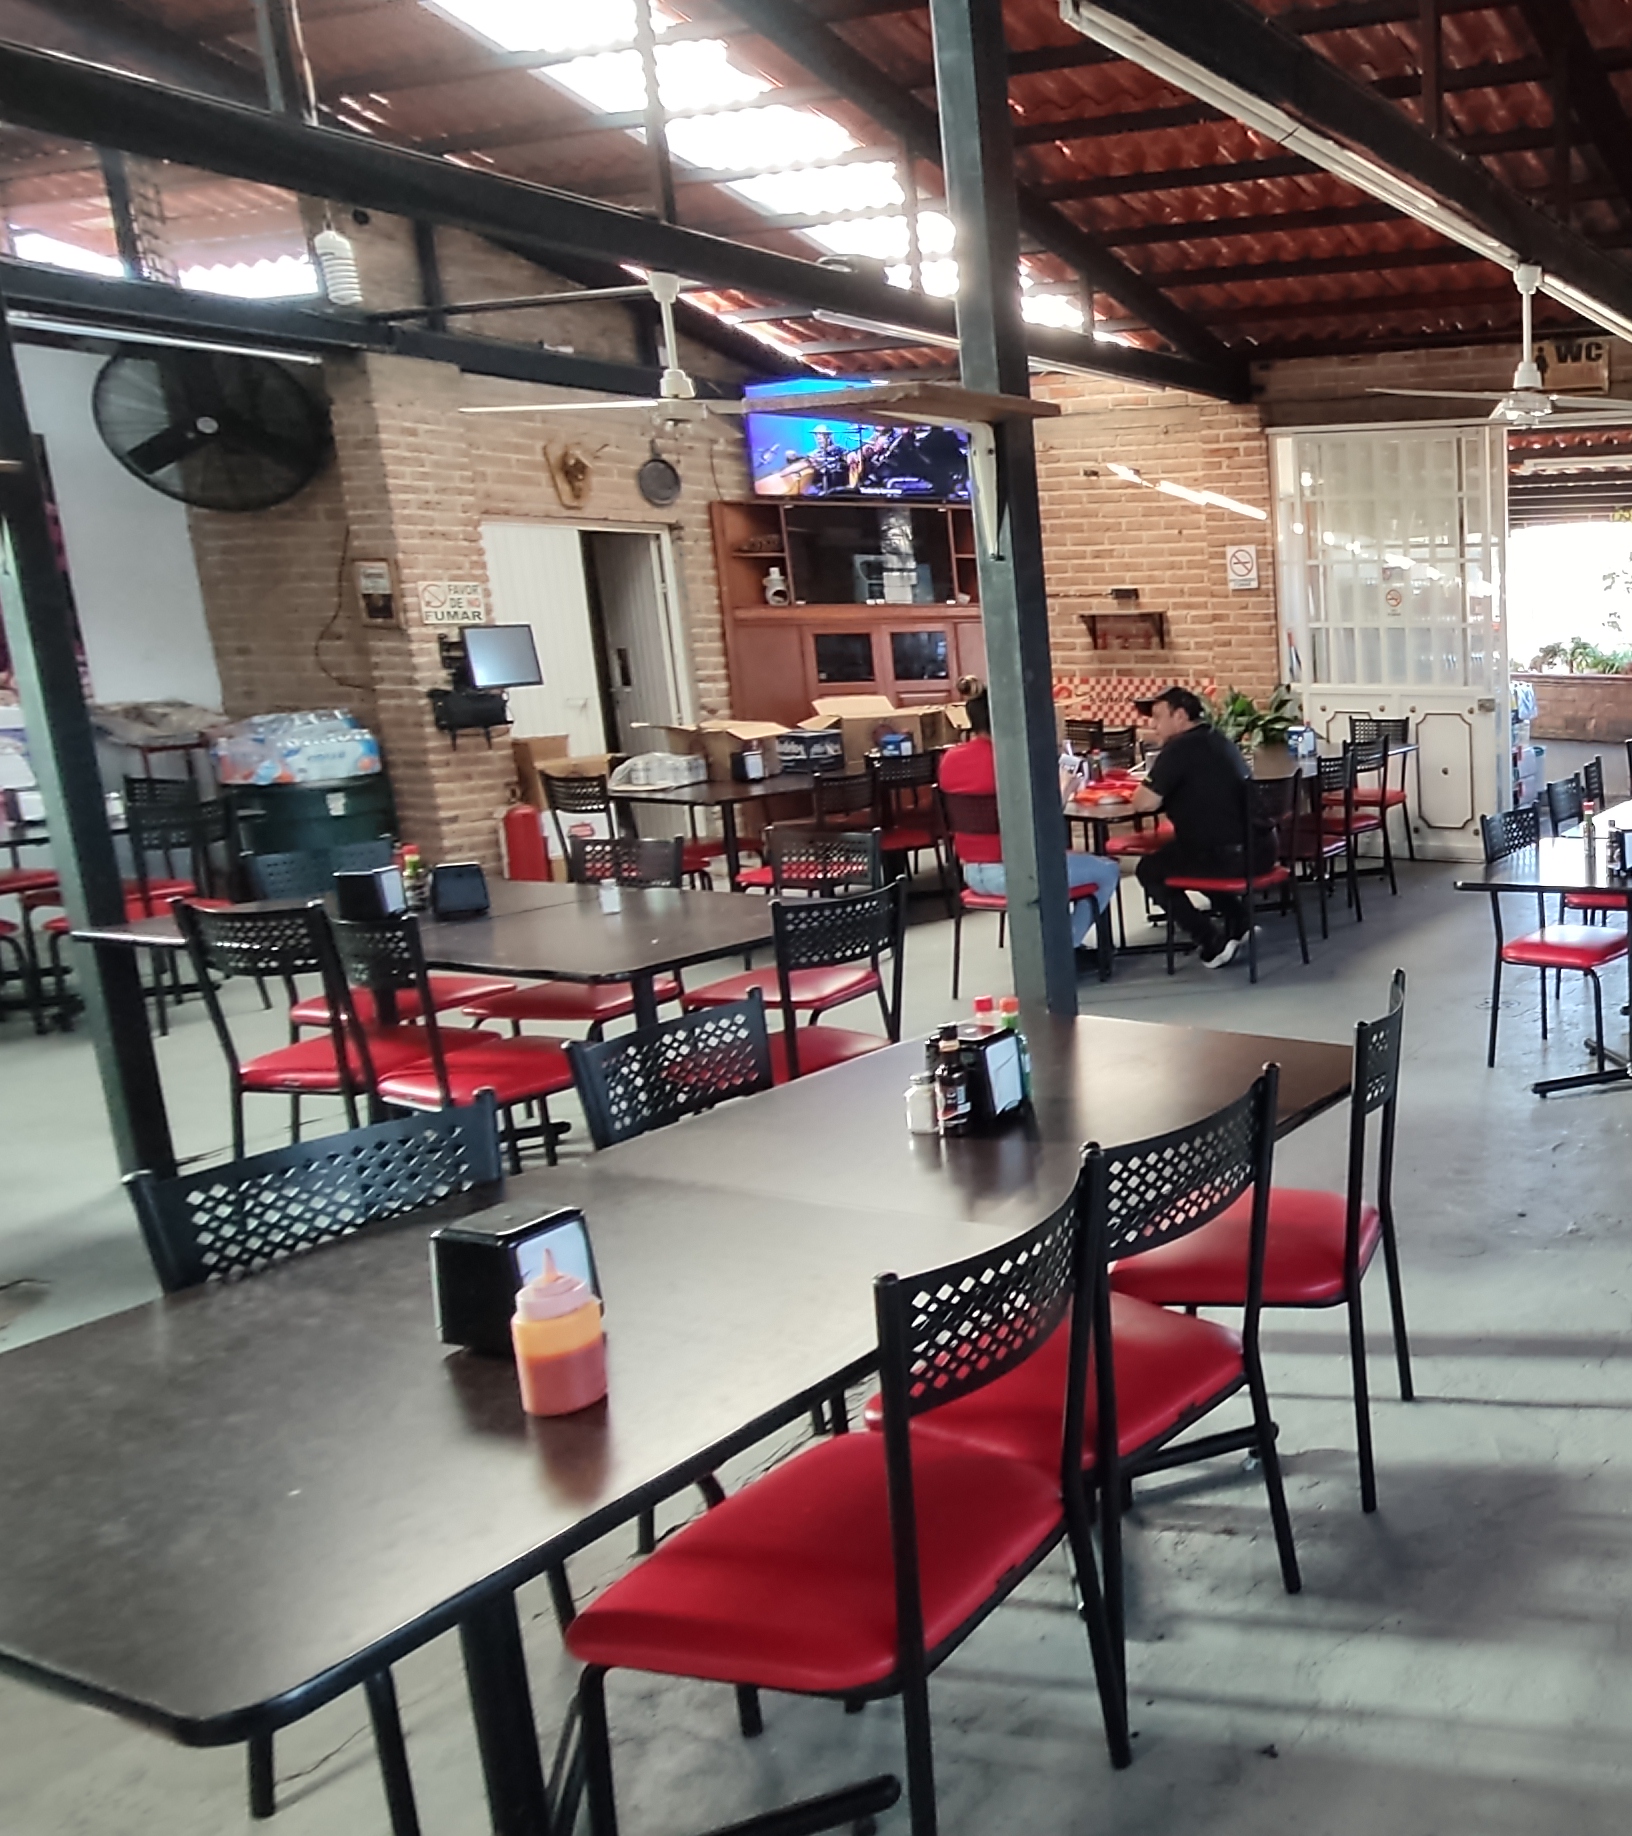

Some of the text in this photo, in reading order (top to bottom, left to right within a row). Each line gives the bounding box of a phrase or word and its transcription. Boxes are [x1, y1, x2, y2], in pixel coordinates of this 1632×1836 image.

[1555, 341, 1603, 363] WC
[447, 584, 479, 595] FAVOR
[449, 598, 464, 608] DE
[424, 611, 483, 621] FUMAR
